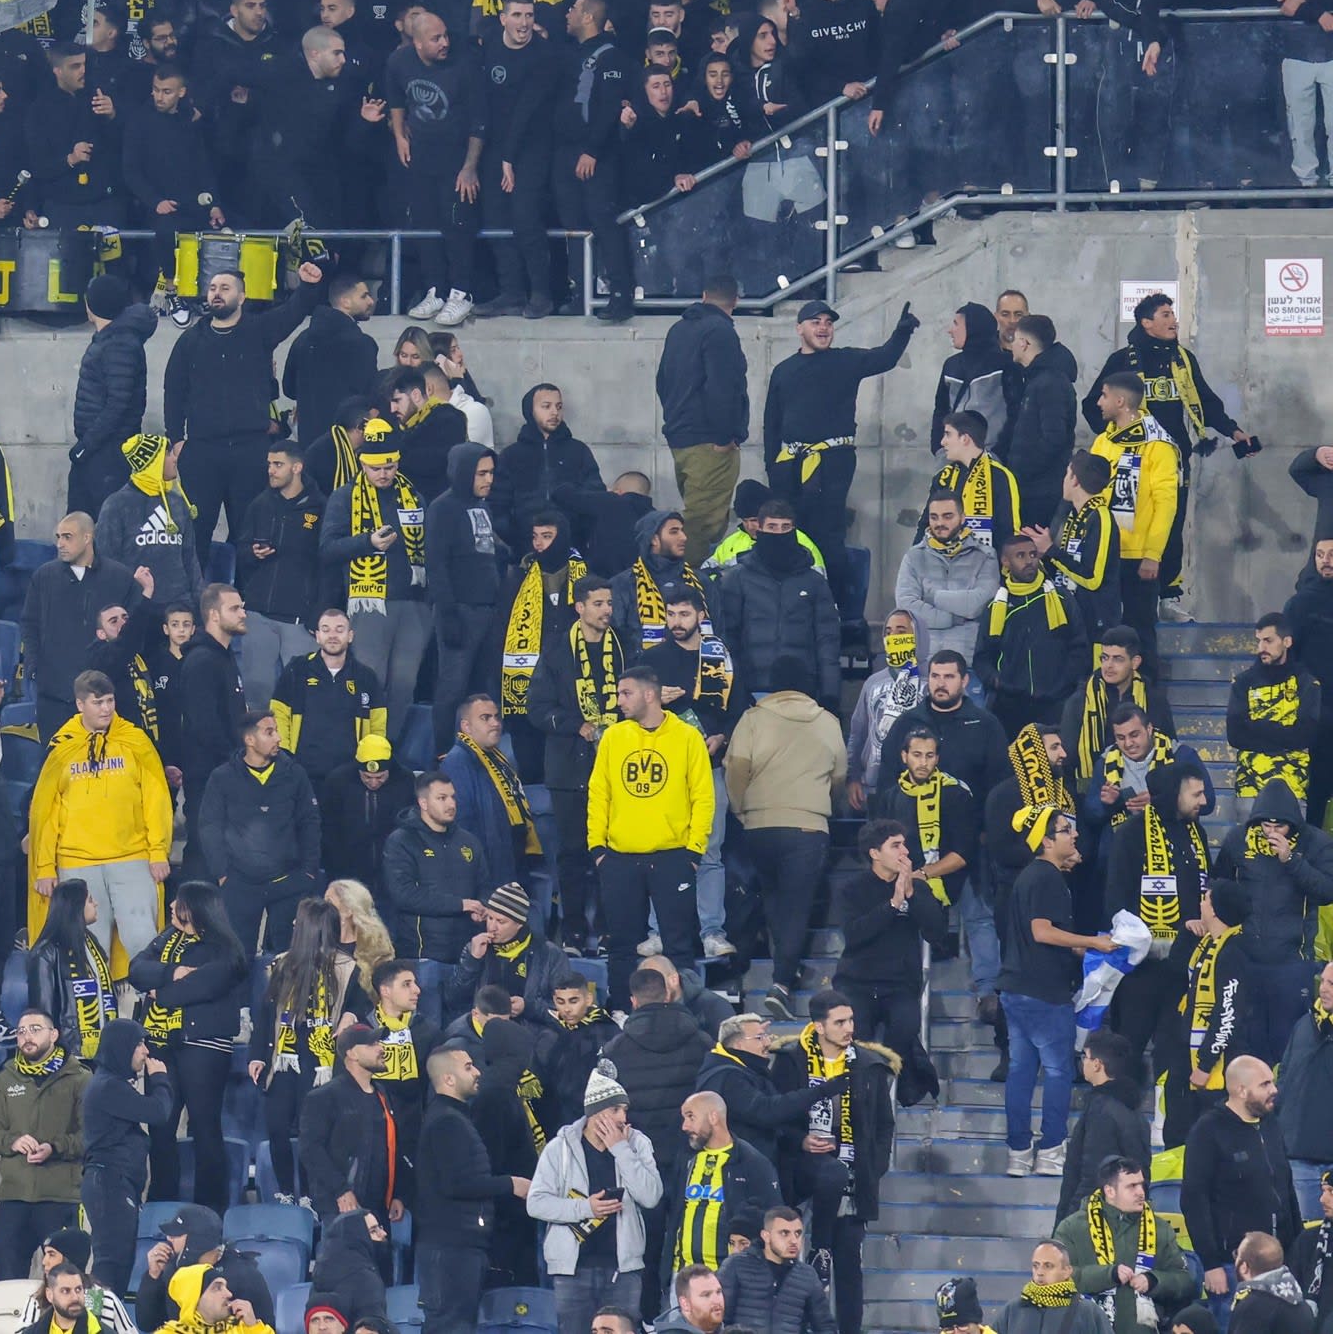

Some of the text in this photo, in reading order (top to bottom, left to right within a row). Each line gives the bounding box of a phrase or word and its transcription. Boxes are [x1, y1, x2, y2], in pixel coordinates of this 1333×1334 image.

[1267, 295, 1322, 307] אסור לעשן
[1267, 306, 1322, 314] NO SMOKING
[134, 528, 183, 547] adidas
[626, 753, 664, 783] BVB
[635, 782, 651, 795] 09
